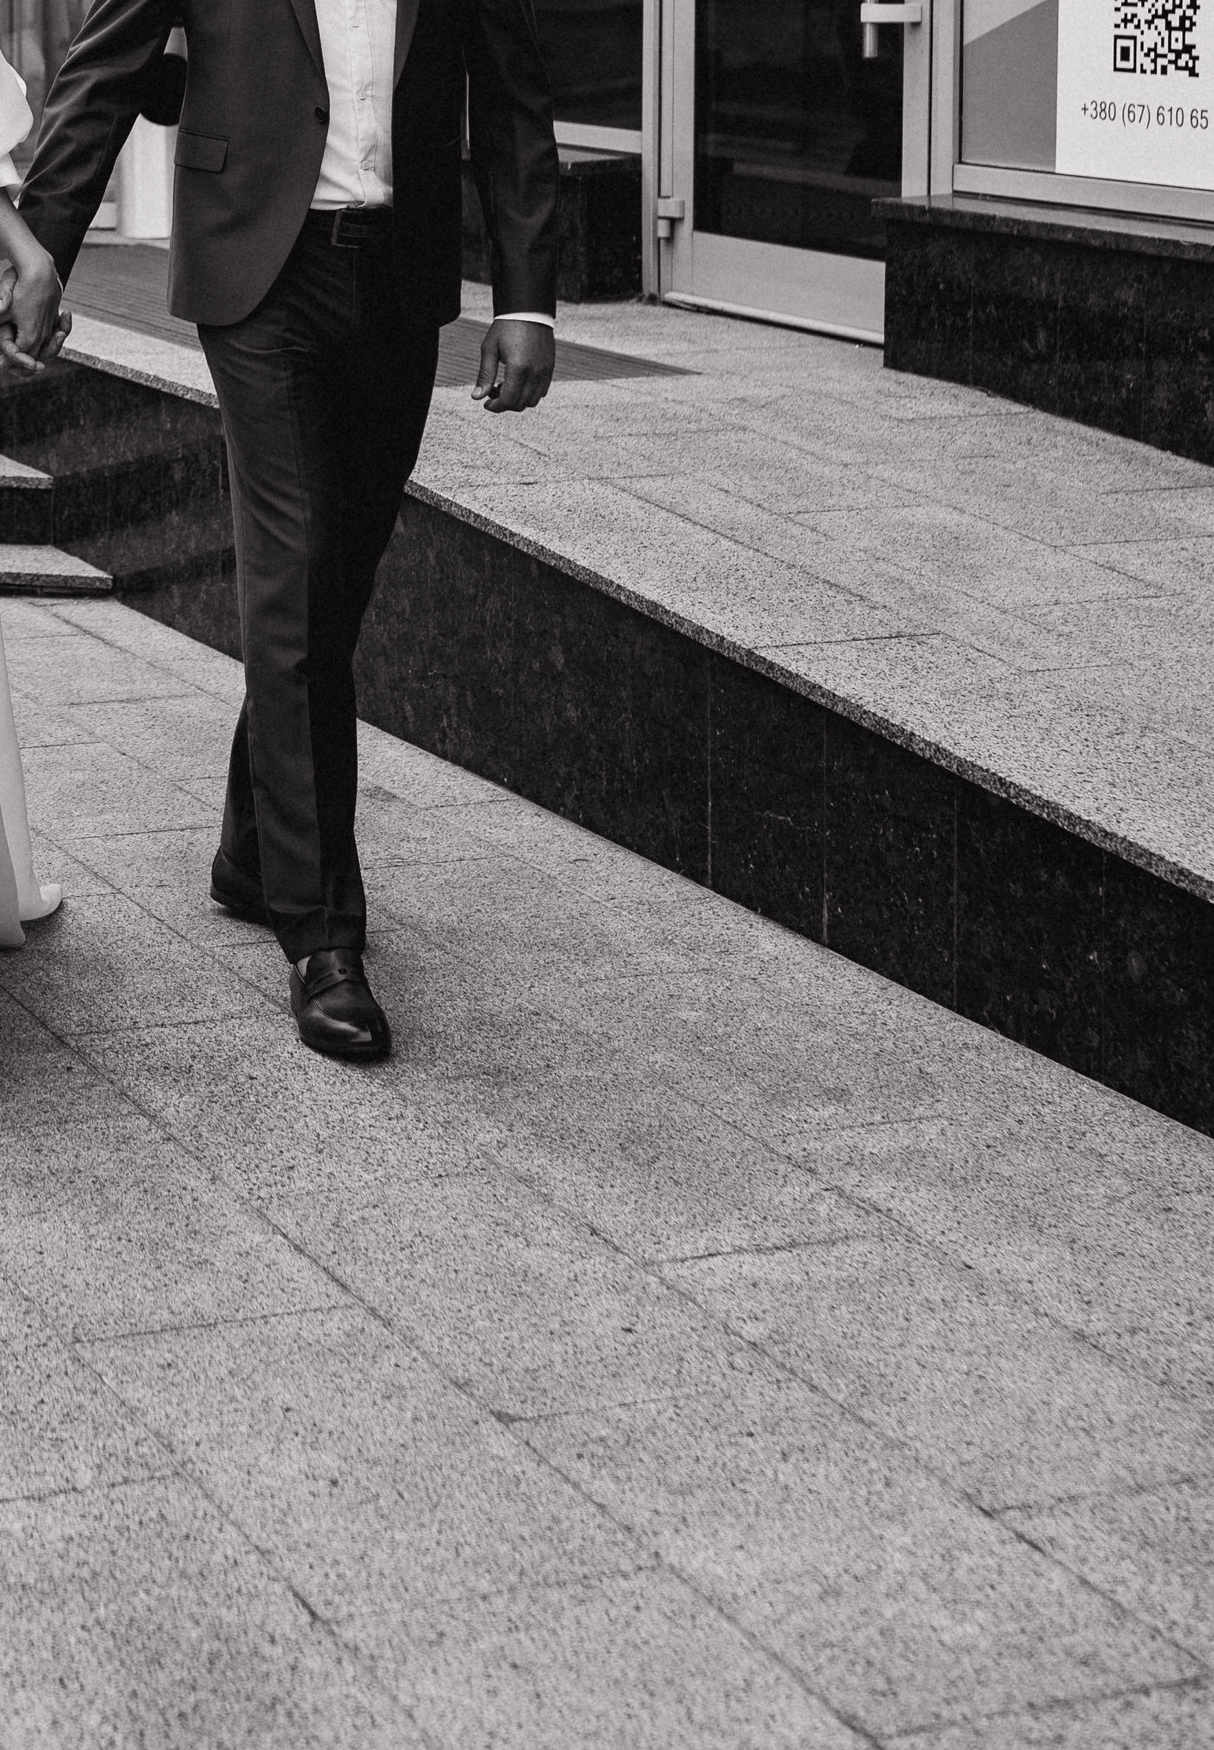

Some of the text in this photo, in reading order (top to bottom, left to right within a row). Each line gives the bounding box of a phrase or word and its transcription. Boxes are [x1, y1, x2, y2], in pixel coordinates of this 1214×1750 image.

[1080, 99, 1210, 130] +380 (67) 610 65
